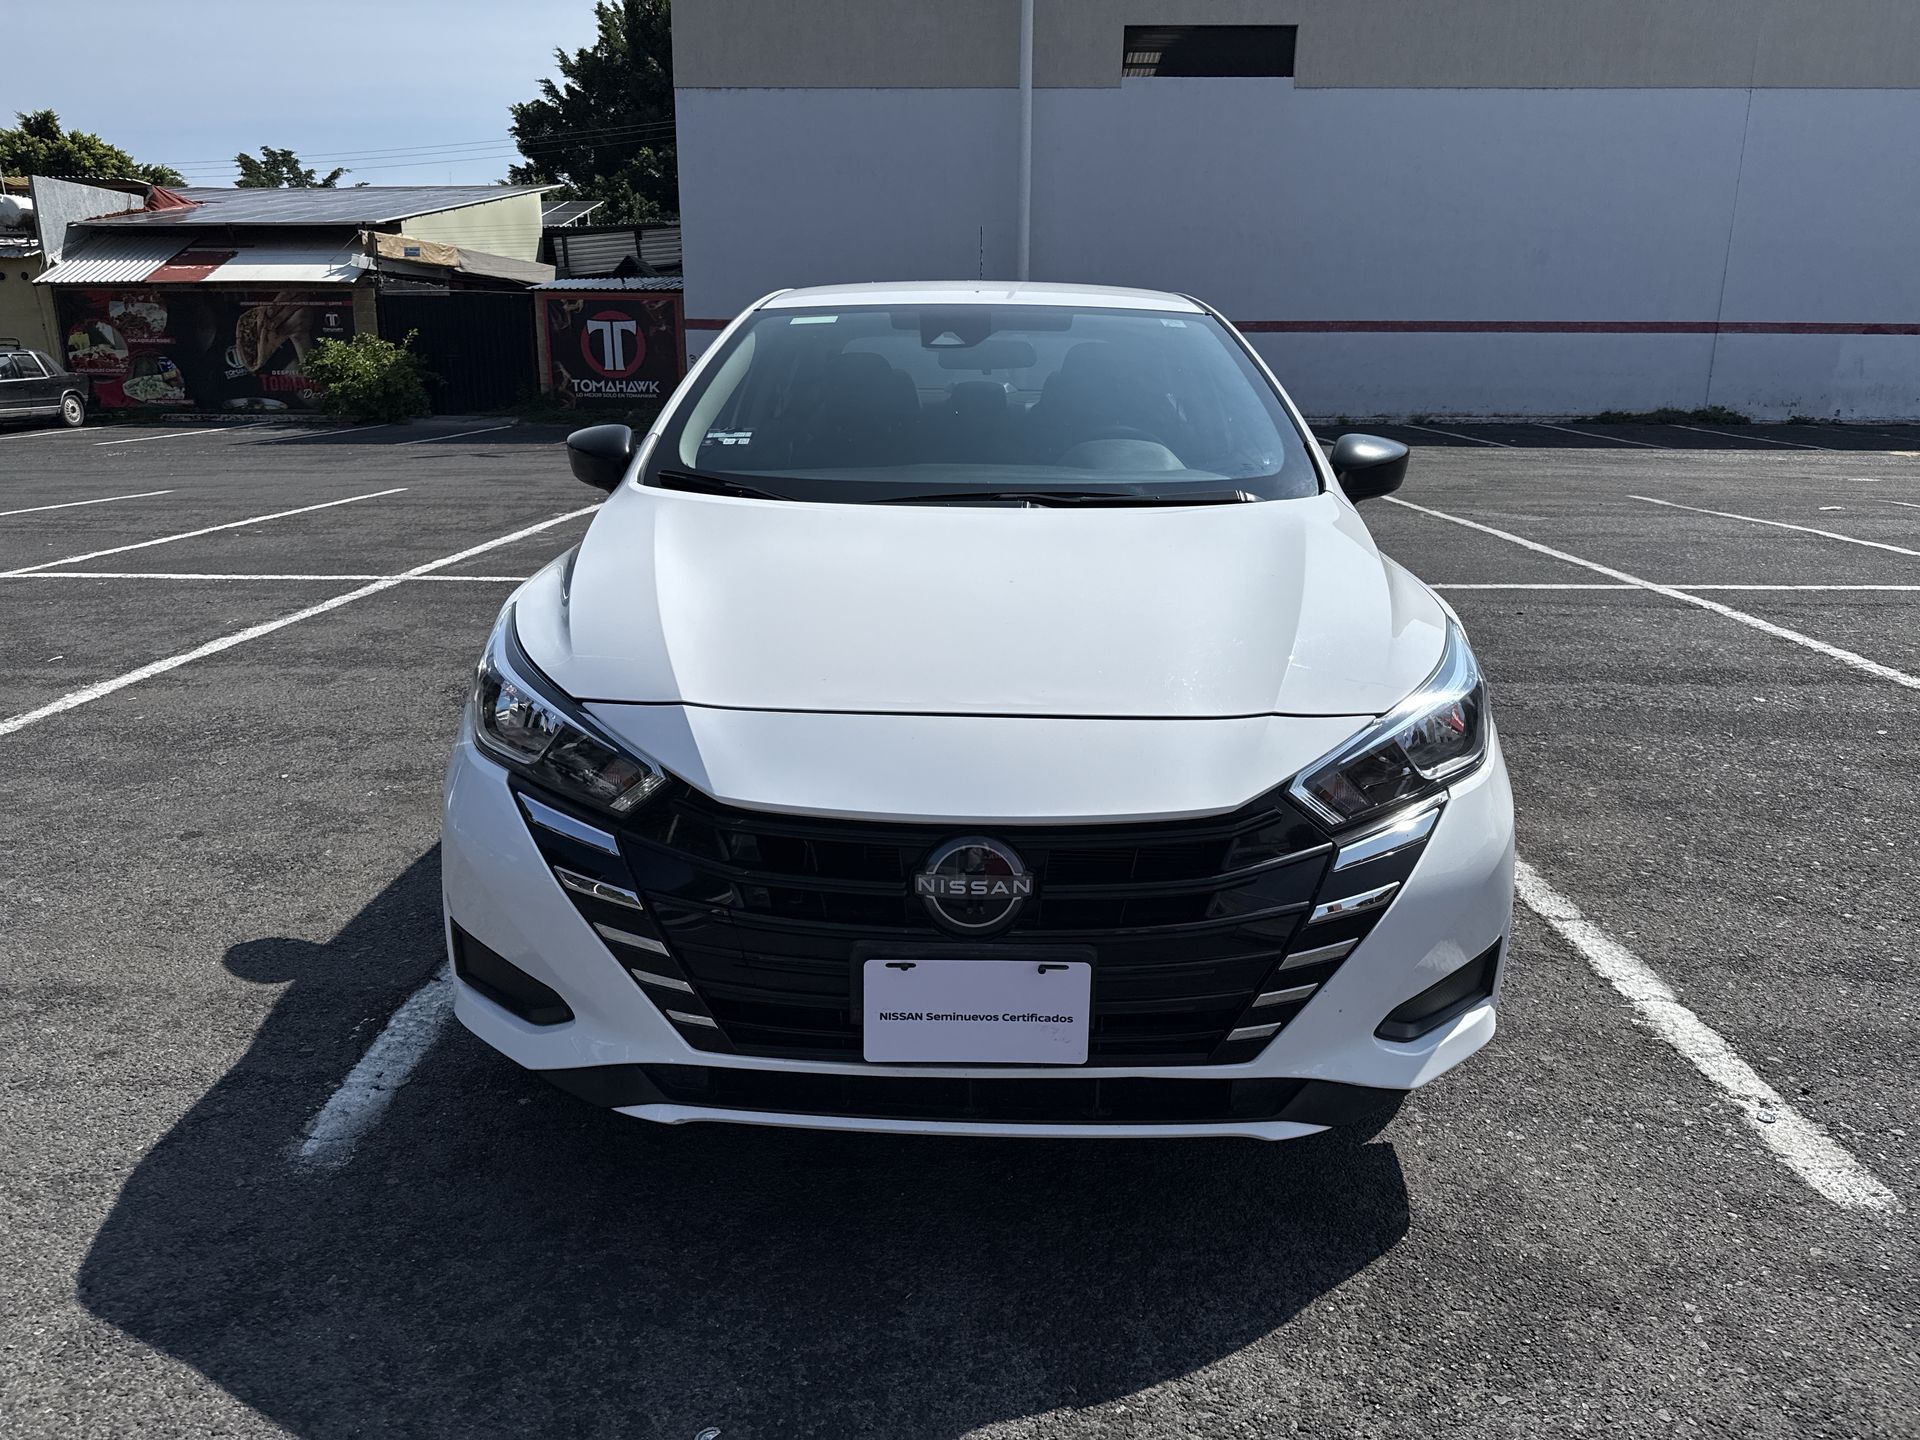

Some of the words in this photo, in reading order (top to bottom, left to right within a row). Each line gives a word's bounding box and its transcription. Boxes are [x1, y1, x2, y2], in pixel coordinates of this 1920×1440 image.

[571, 379, 660, 393] TOMAHAWK
[918, 878, 1030, 895] NISSAN
[879, 1012, 923, 1021] NISSAN
[926, 1012, 999, 1022] Seminuevos
[1002, 1012, 1074, 1023] Certificados
